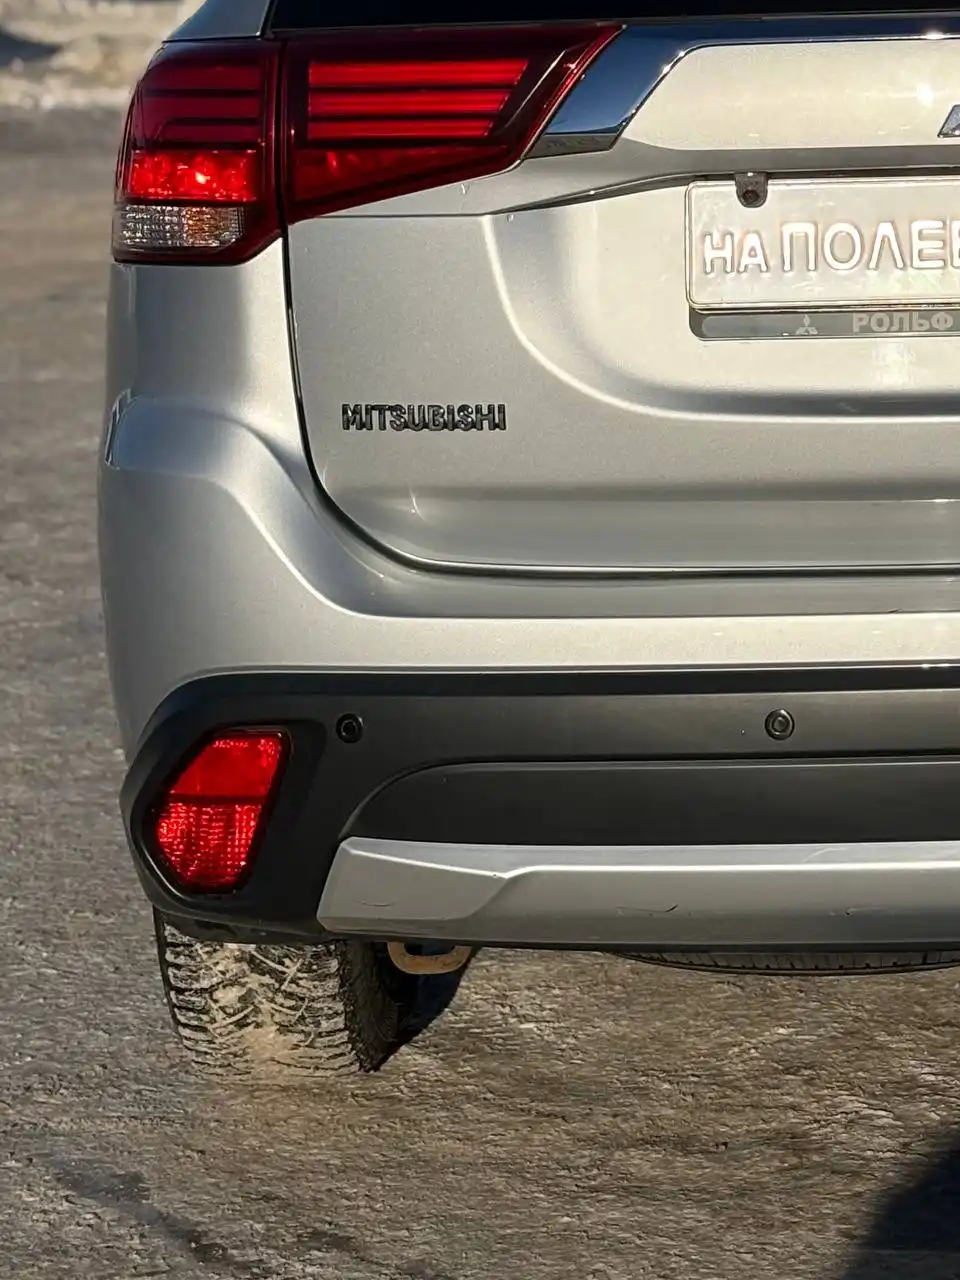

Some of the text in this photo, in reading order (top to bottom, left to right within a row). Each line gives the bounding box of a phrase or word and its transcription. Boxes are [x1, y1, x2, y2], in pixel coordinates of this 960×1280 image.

[703, 231, 769, 274] НА
[852, 311, 955, 333] РОЛЬФ
[341, 403, 508, 432] MITSUBISHI
